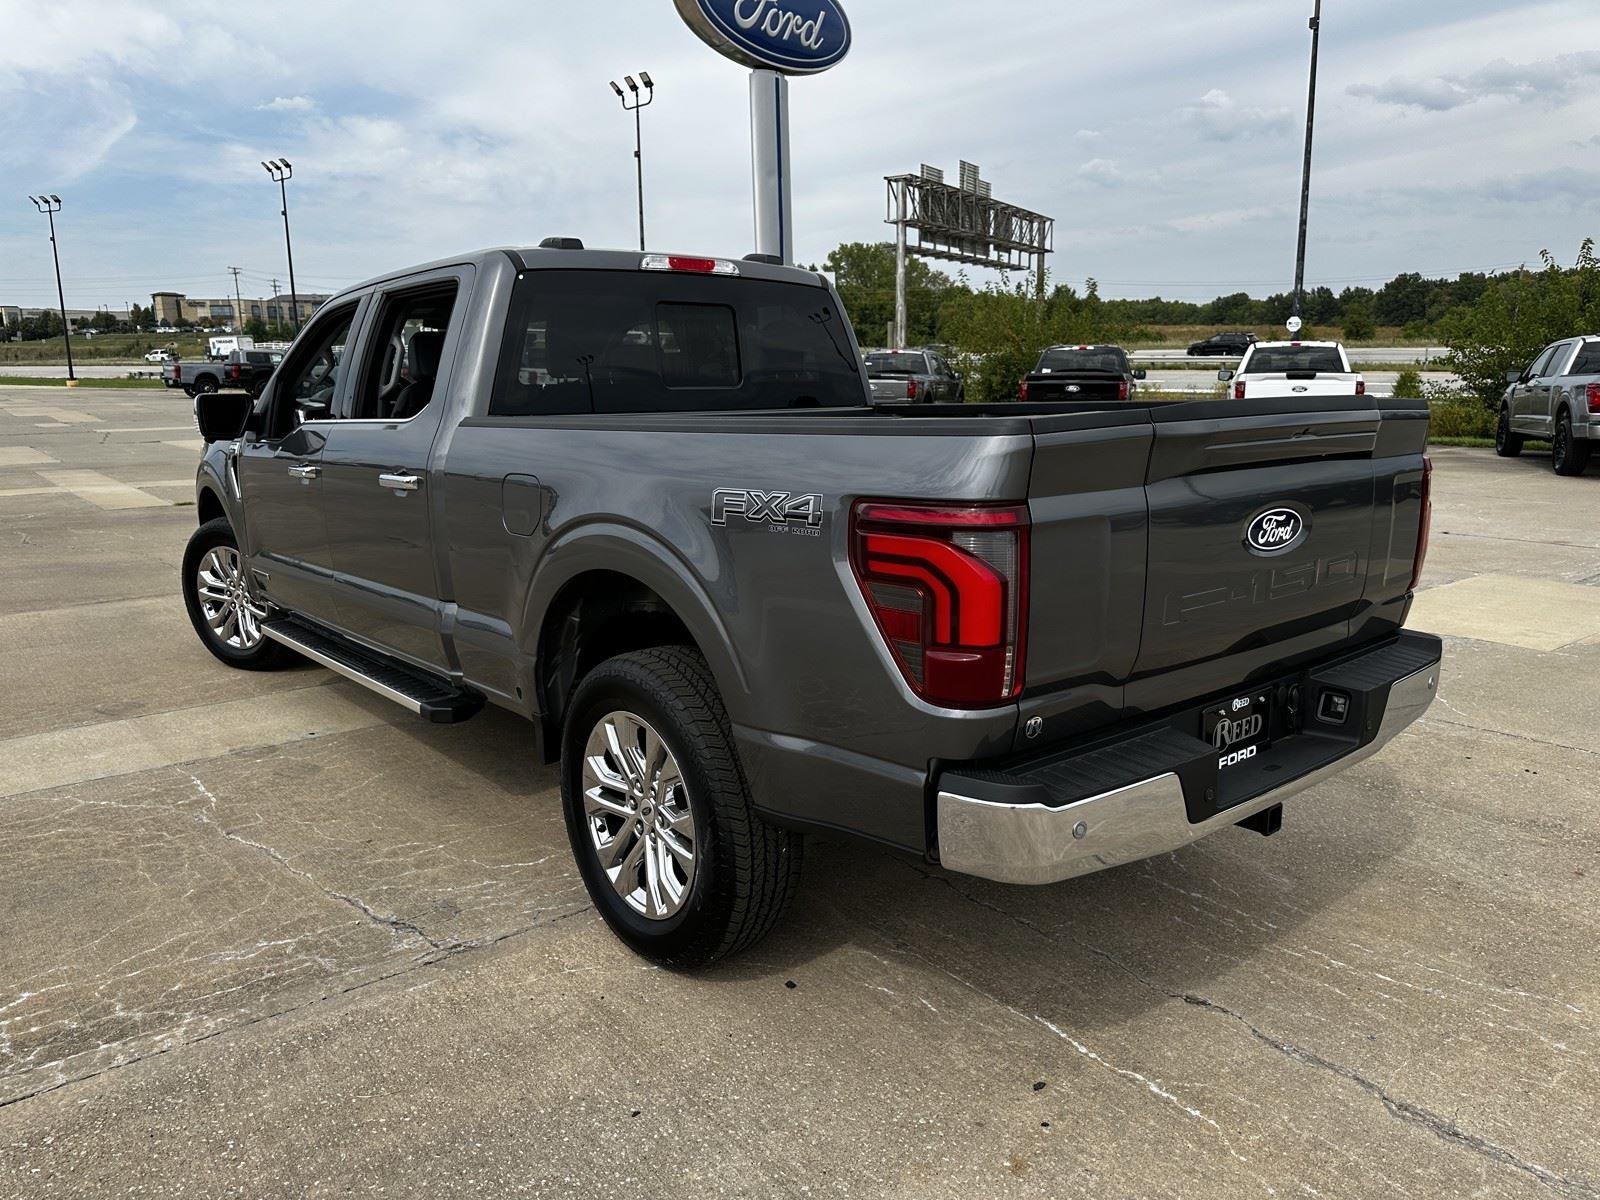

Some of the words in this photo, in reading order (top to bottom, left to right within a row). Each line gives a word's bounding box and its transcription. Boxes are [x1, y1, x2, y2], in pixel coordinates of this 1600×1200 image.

[711, 487, 823, 528] FX4
[1258, 514, 1294, 544] Ford
[1163, 551, 1359, 625] F-150
[1218, 745, 1257, 769] FORD
